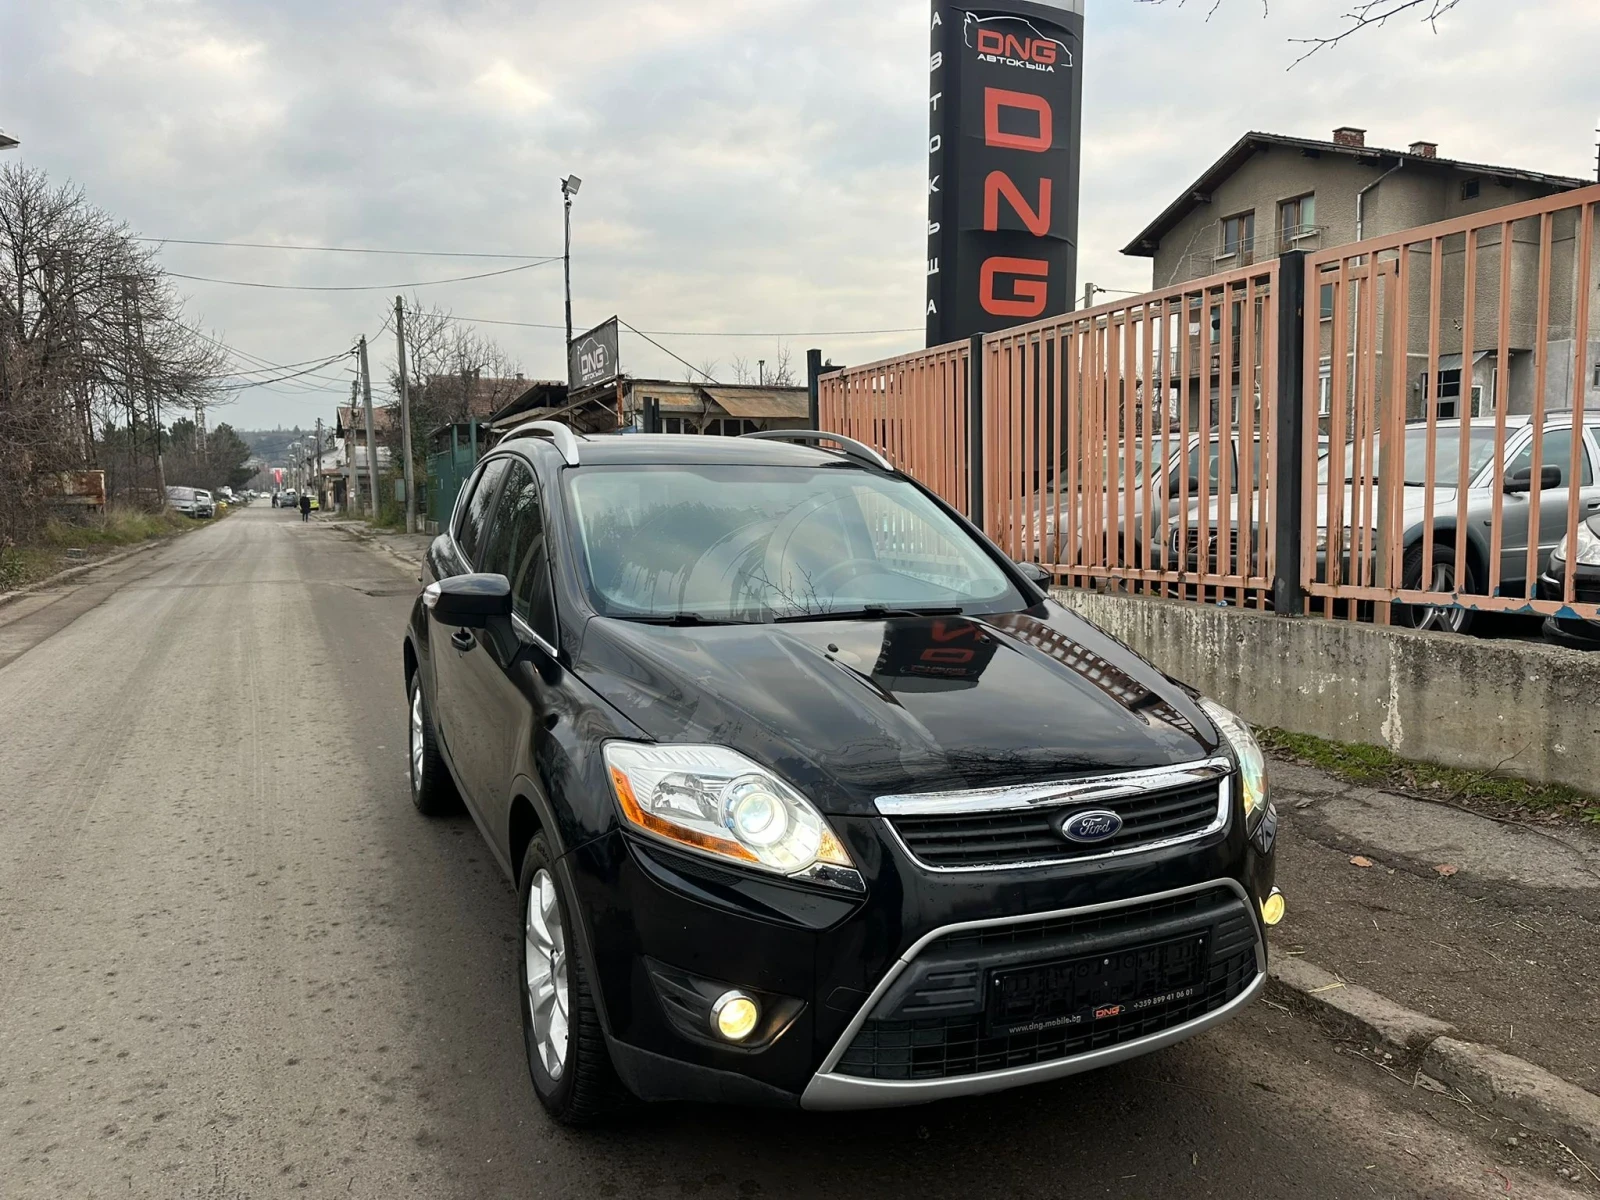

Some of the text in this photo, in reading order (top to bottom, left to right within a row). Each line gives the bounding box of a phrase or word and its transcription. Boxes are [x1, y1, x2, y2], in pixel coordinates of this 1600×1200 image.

[977, 29, 1056, 64] DNG
[979, 87, 1052, 317] DNG
[581, 347, 603, 375] DNG
[1079, 818, 1110, 835] Ford
[1009, 1015, 1081, 1033] www.dng.mobile.bg
[1095, 1006, 1119, 1017] DNG
[1134, 999, 1151, 1008] +359
[1153, 995, 1165, 1004] 899
